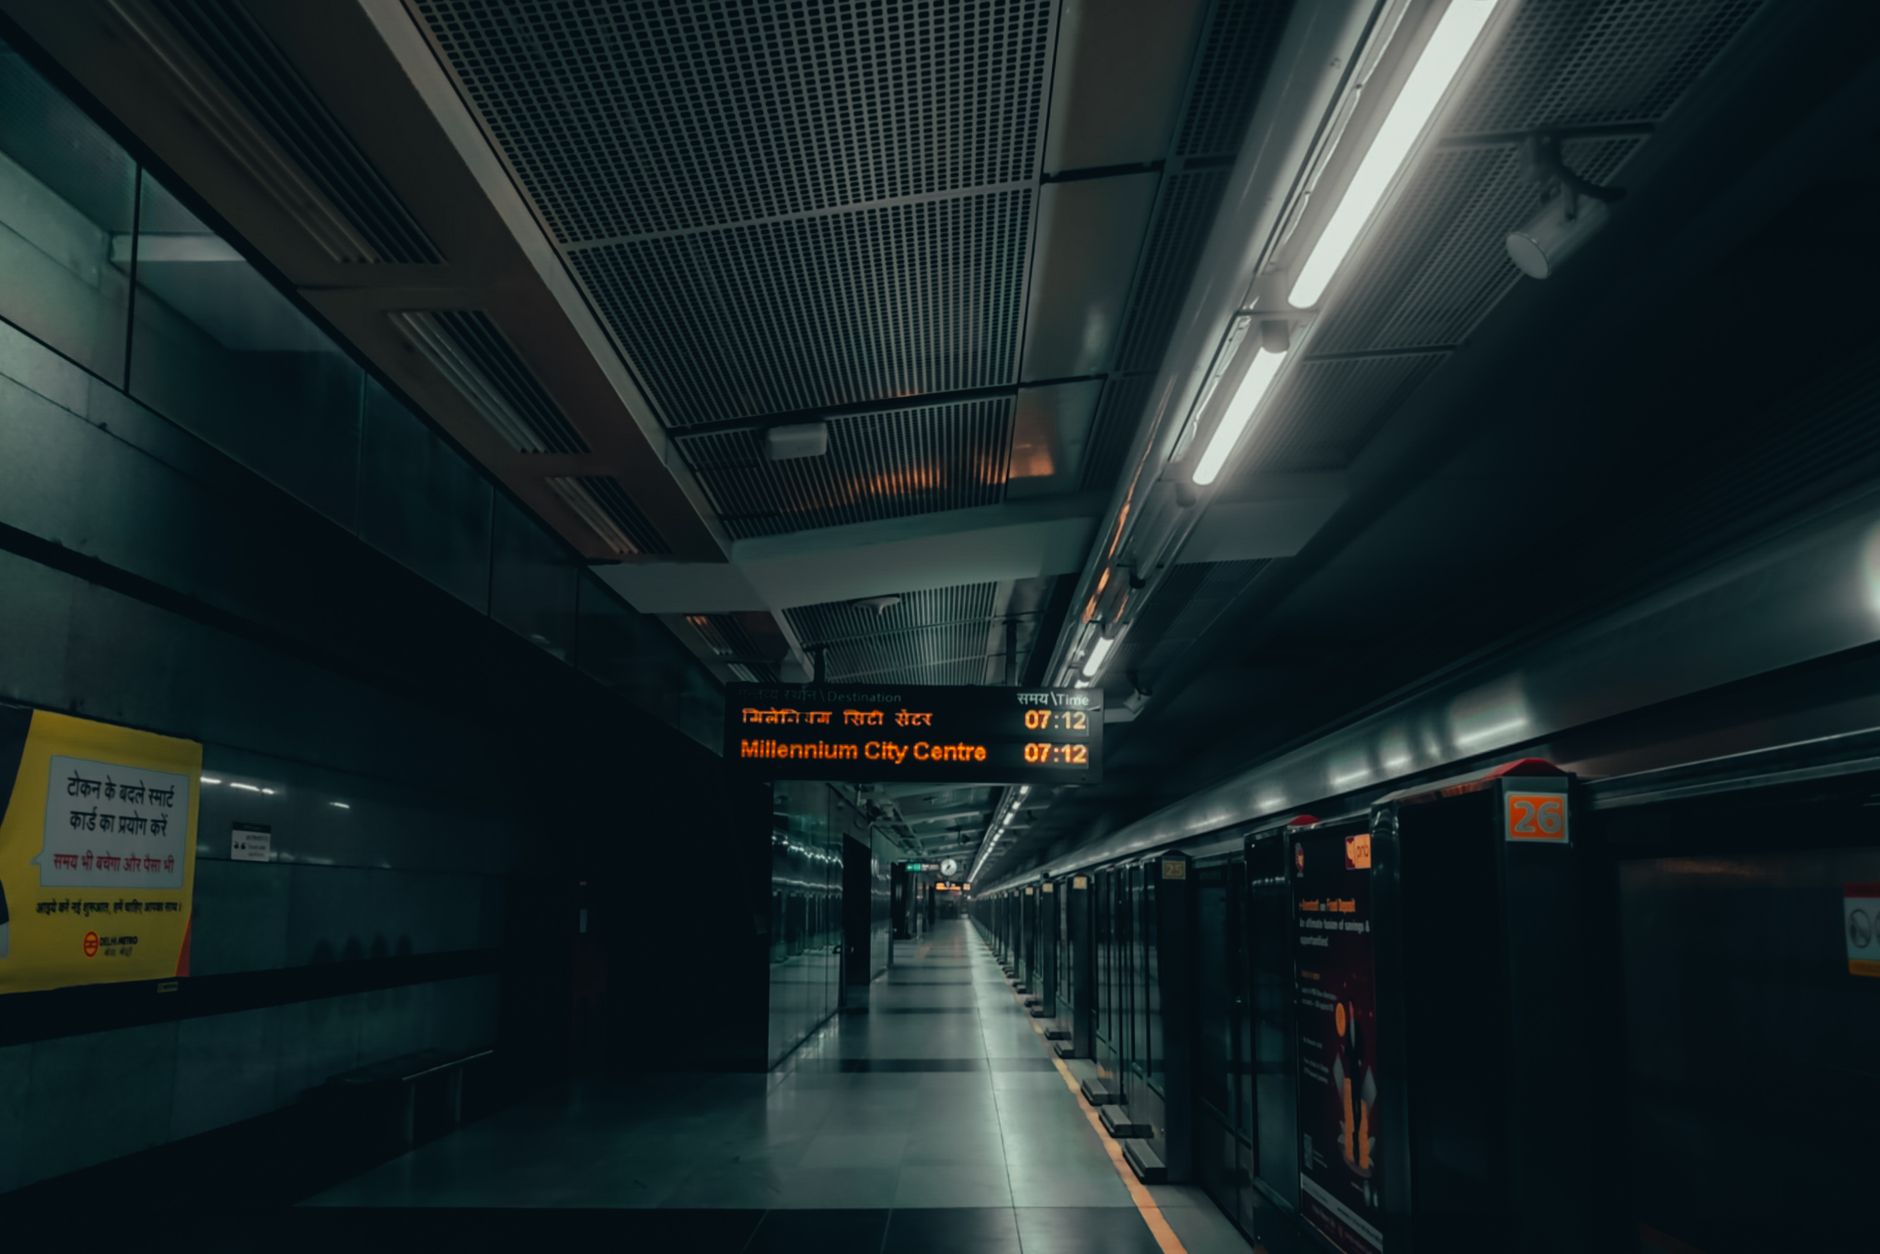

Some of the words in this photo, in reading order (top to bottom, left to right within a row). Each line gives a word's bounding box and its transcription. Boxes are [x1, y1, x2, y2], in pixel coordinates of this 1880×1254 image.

[843, 709, 885, 726] सिटी
[1024, 709, 1087, 730] 07:12
[740, 739, 858, 760] Millennium
[864, 740, 909, 765] City
[913, 741, 988, 762] Centre
[1024, 742, 1087, 763] 07:12
[67, 769, 101, 799] टोकन
[105, 775, 116, 800] के
[119, 780, 145, 804] बदले
[148, 785, 175, 808] स्मार्ट
[70, 807, 98, 831] कार्ड
[100, 814, 115, 832] का
[119, 810, 147, 836] प्रयोग
[150, 813, 168, 836] करें
[1513, 801, 1562, 834] 26
[54, 854, 78, 870] समय
[81, 850, 93, 871] भी
[163, 854, 175, 873] भी
